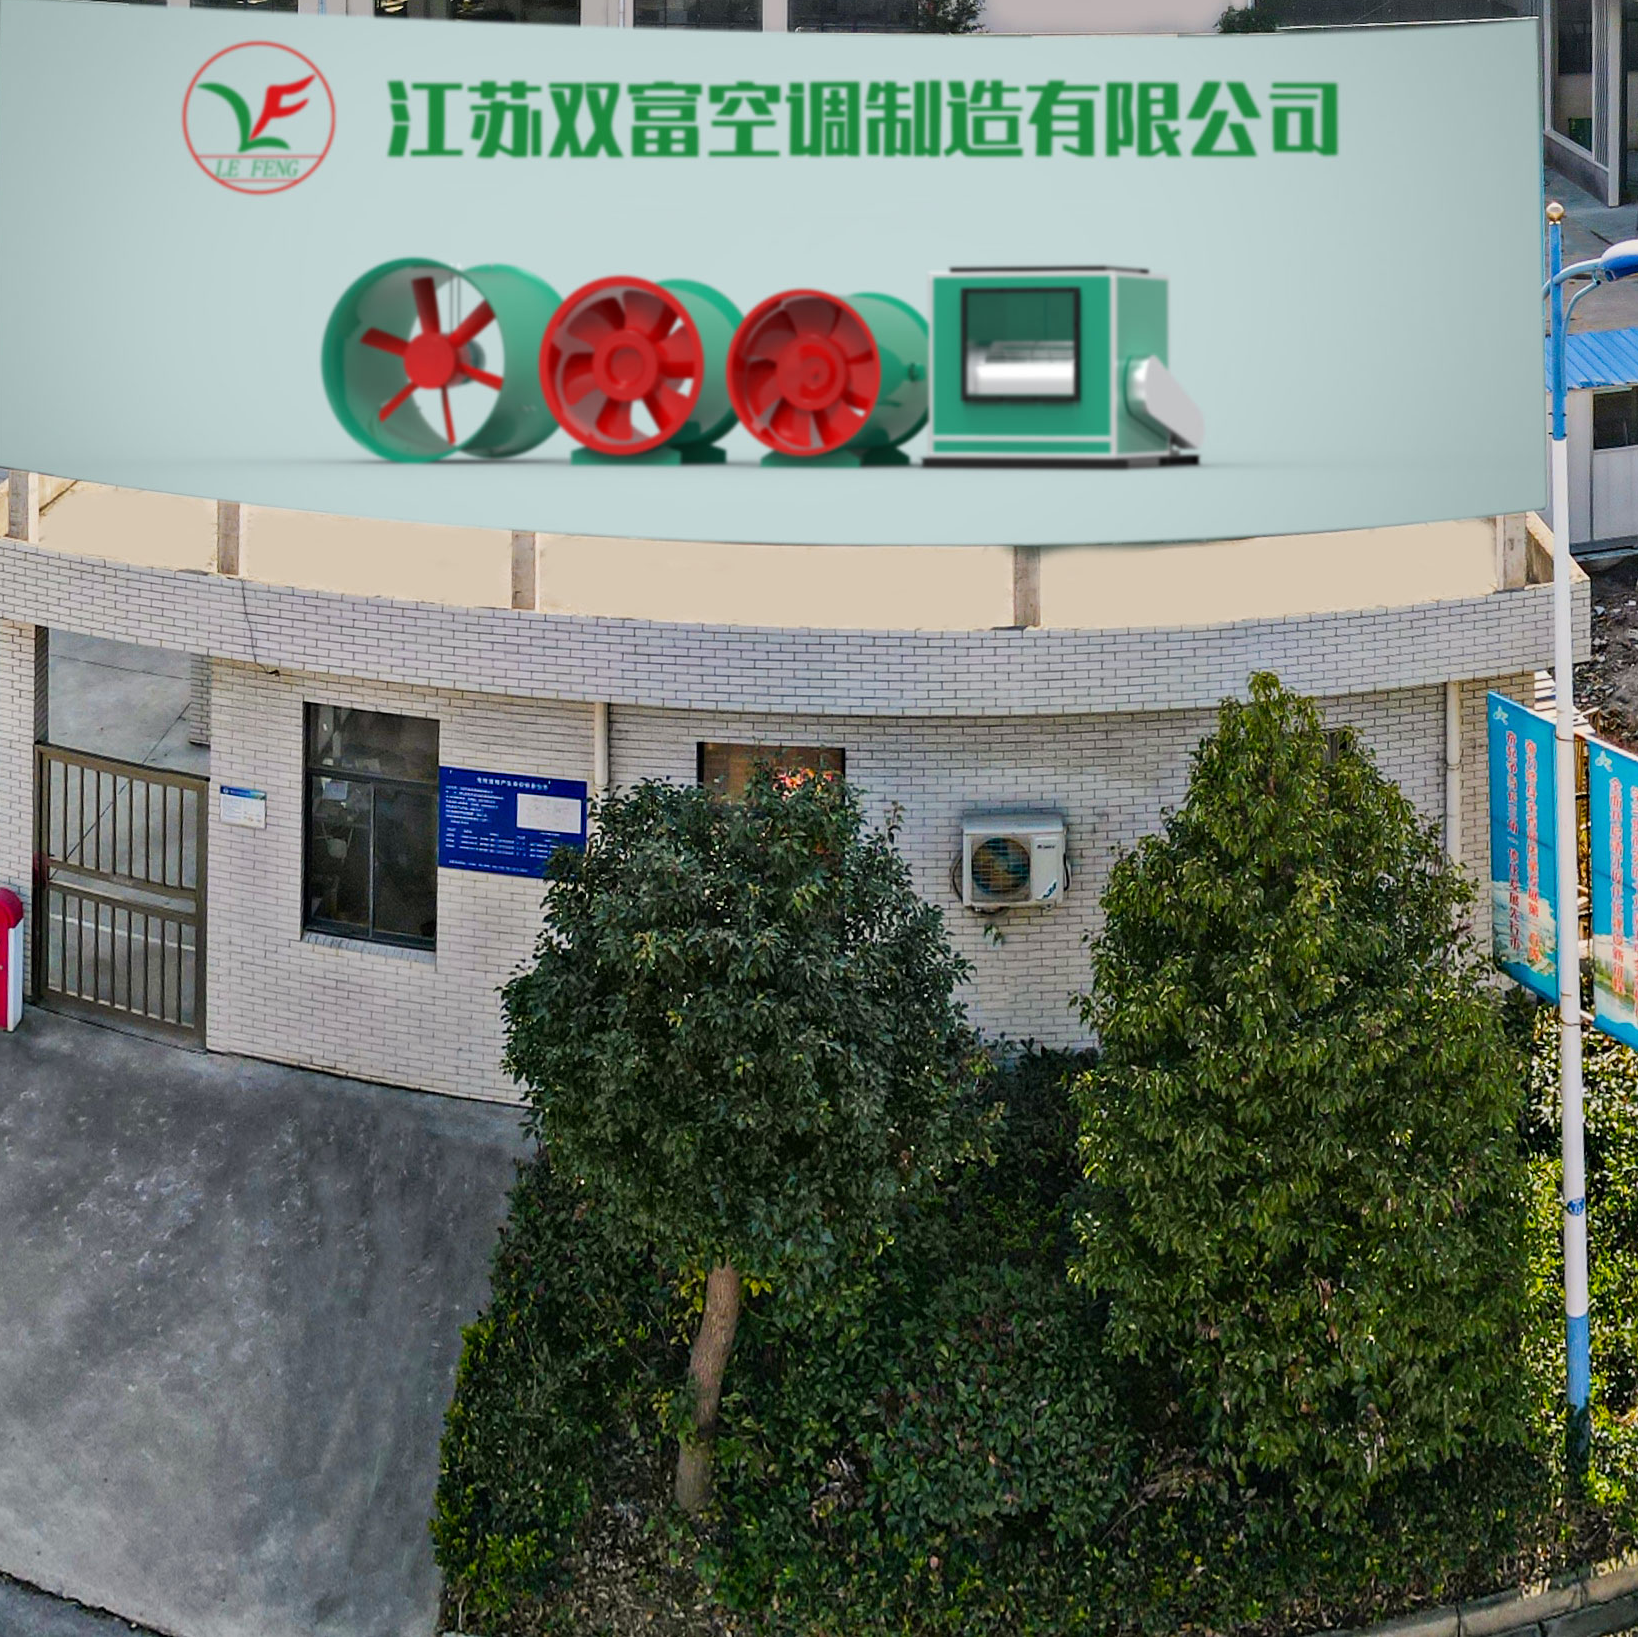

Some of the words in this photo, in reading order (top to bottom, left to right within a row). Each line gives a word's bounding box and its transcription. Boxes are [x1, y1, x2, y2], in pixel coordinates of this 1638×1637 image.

[387, 80, 1339, 159] 江苏双富空调制造有限公司
[216, 159, 241, 178] LE
[251, 159, 299, 178] FENG
